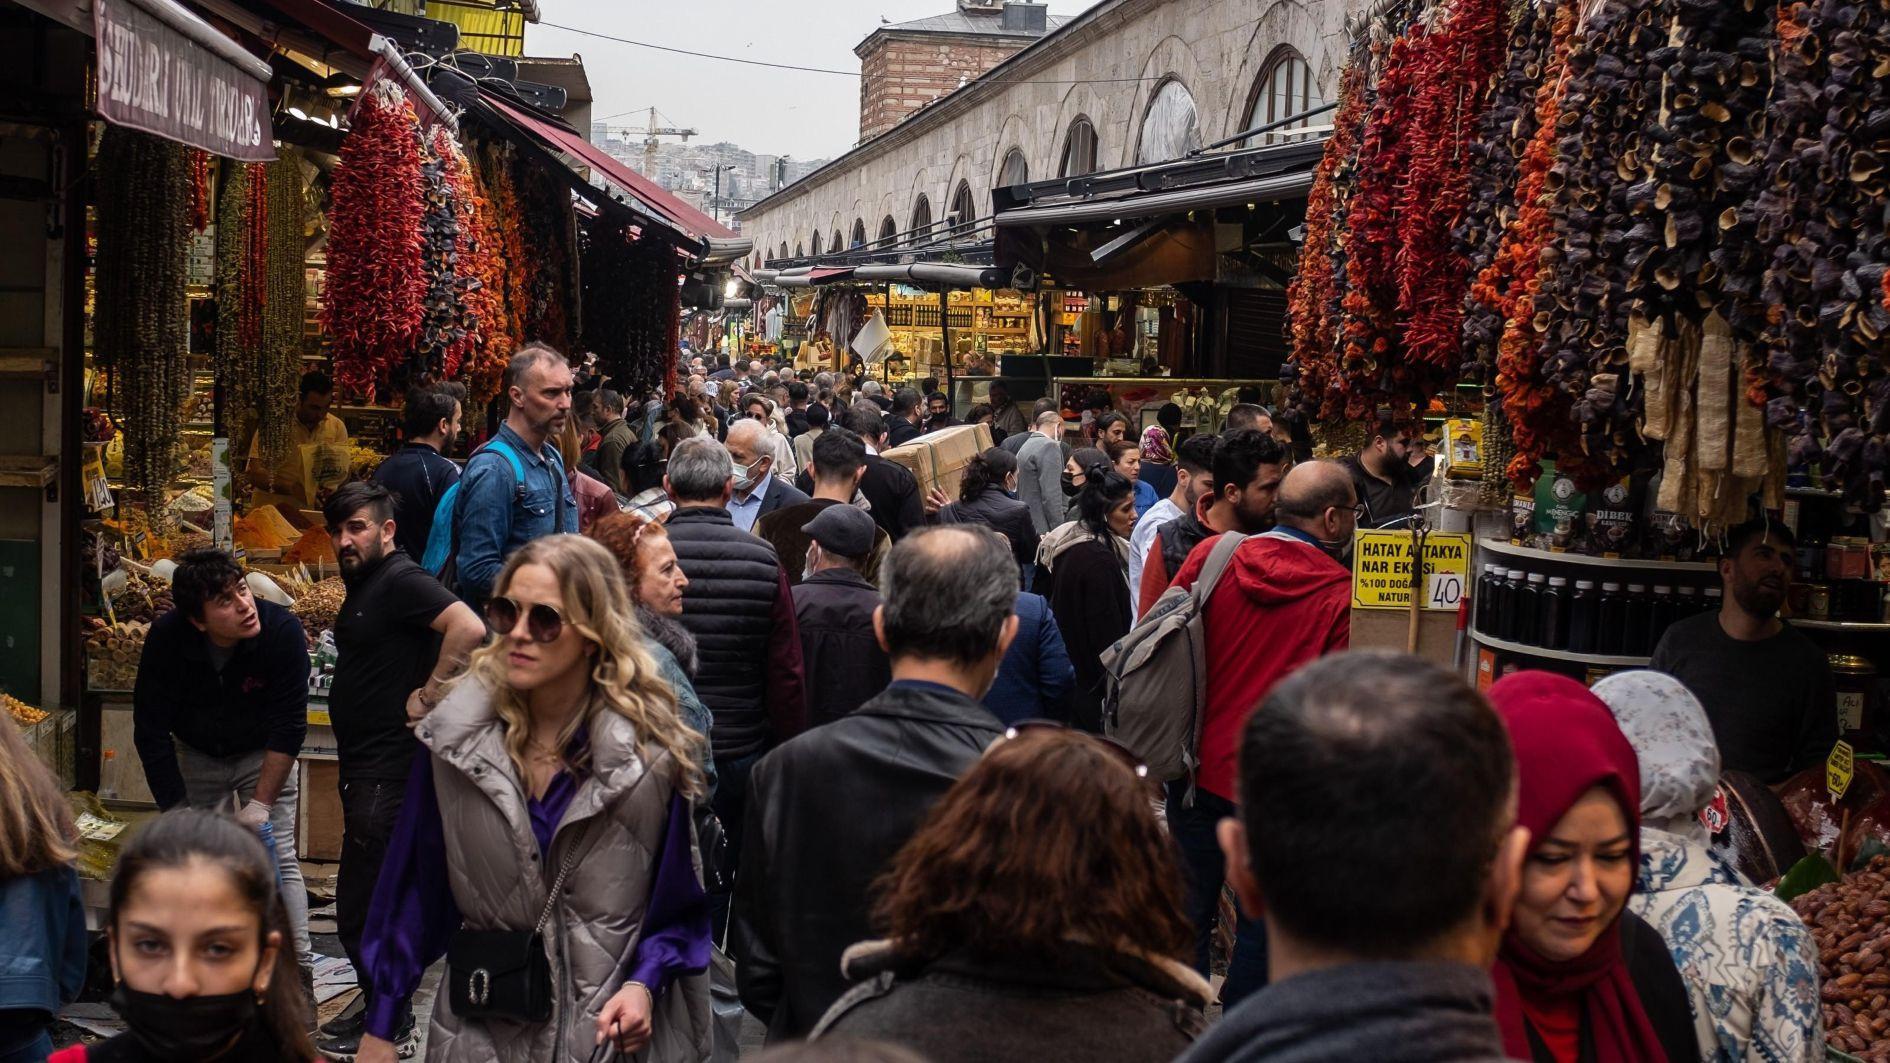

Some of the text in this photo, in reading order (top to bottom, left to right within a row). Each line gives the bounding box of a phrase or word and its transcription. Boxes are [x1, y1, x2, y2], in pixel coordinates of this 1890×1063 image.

[1363, 543, 1462, 559] HATAY ATAKYA
[1362, 561, 1388, 574] NAR
[1389, 577, 1413, 588] DOĞA
[1378, 592, 1412, 602] NATUR
